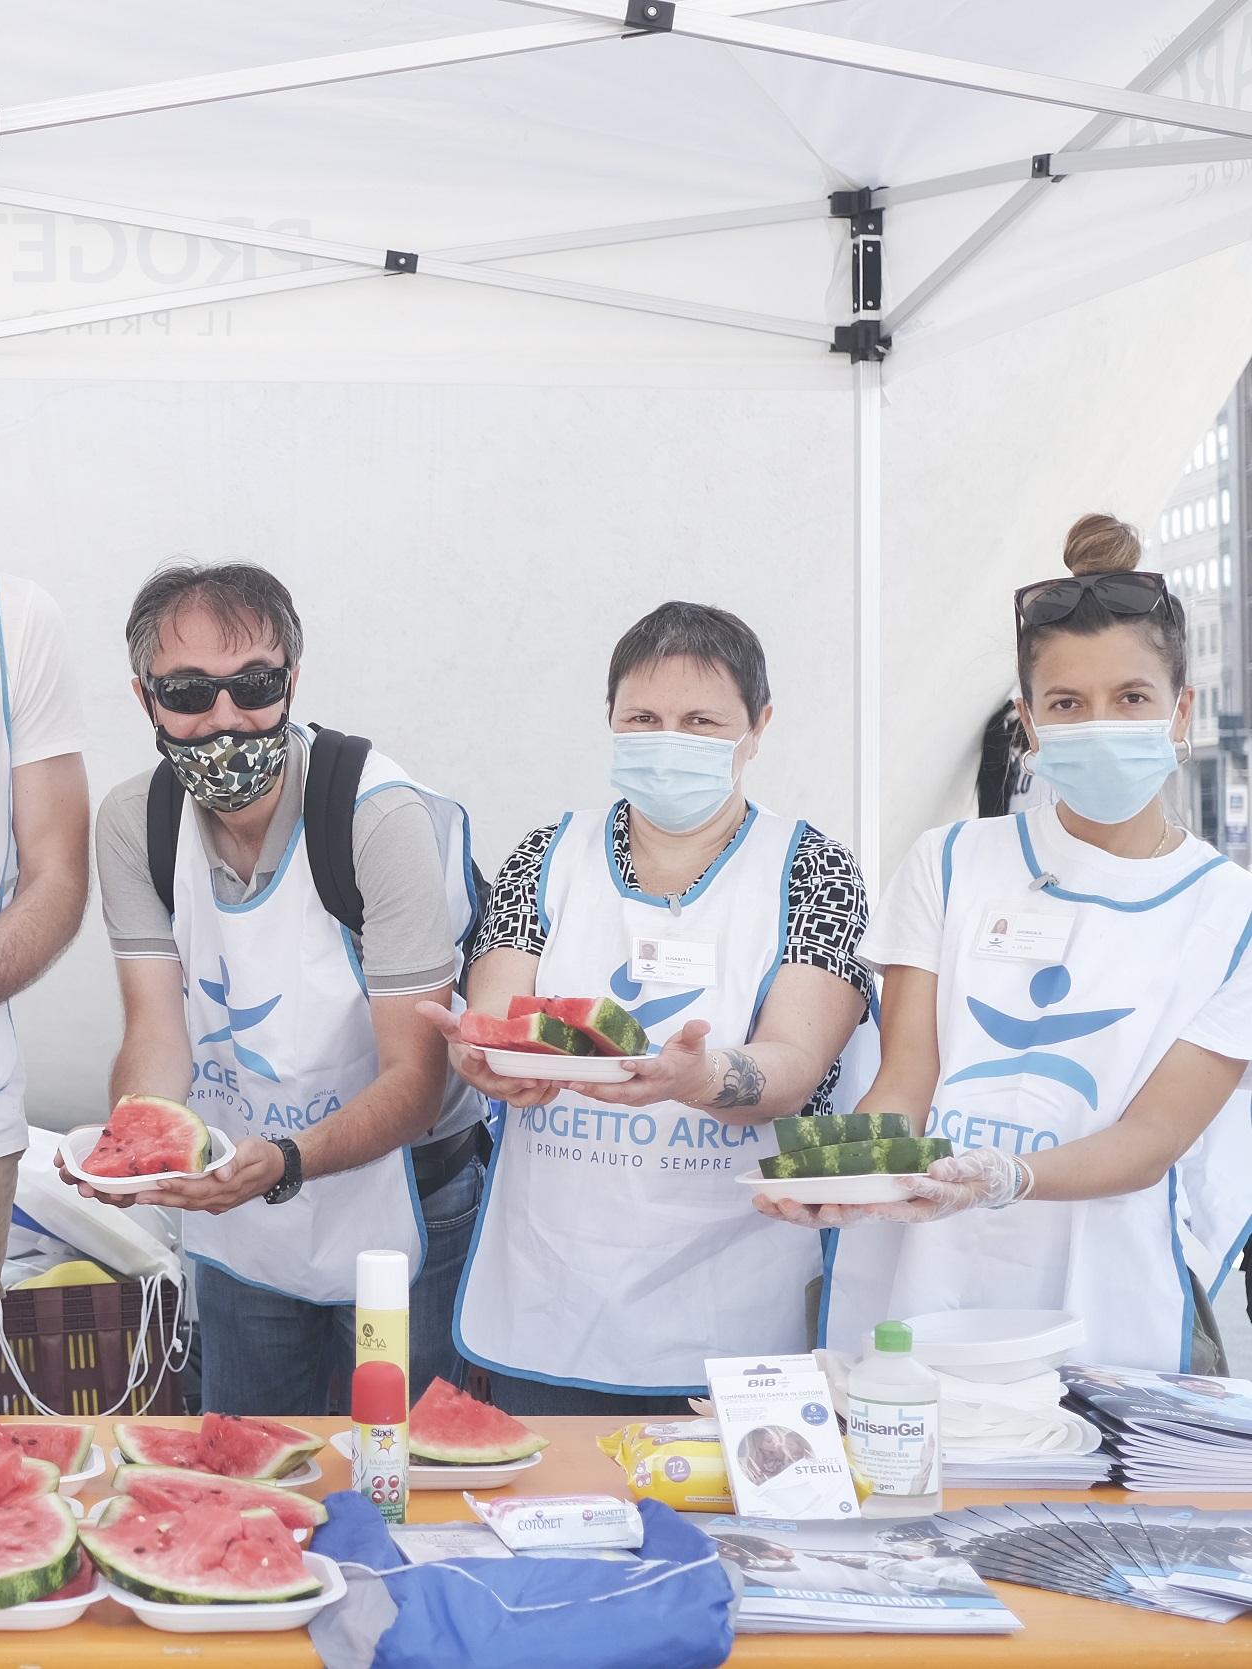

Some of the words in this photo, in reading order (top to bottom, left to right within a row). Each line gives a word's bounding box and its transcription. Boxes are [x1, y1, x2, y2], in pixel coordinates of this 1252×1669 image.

[314, 1088, 337, 1099] onlus
[264, 1095, 342, 1131] ARCA
[519, 1105, 656, 1146] PROGETTO
[668, 1116, 760, 1149] ARCA
[925, 1105, 1059, 1155] OGETTO
[537, 1143, 582, 1161] PRIMO
[590, 1150, 643, 1167] AIUTO
[661, 1157, 732, 1170] SEMPRE
[371, 1428, 395, 1438] Stack
[851, 1415, 924, 1437] UnisanGel
[668, 1460, 685, 1474] 72
[795, 1464, 843, 1475] STERILI
[594, 1508, 627, 1517] SALVIETTE
[517, 1517, 562, 1531] COTONET
[707, 1516, 798, 1532] Arca
